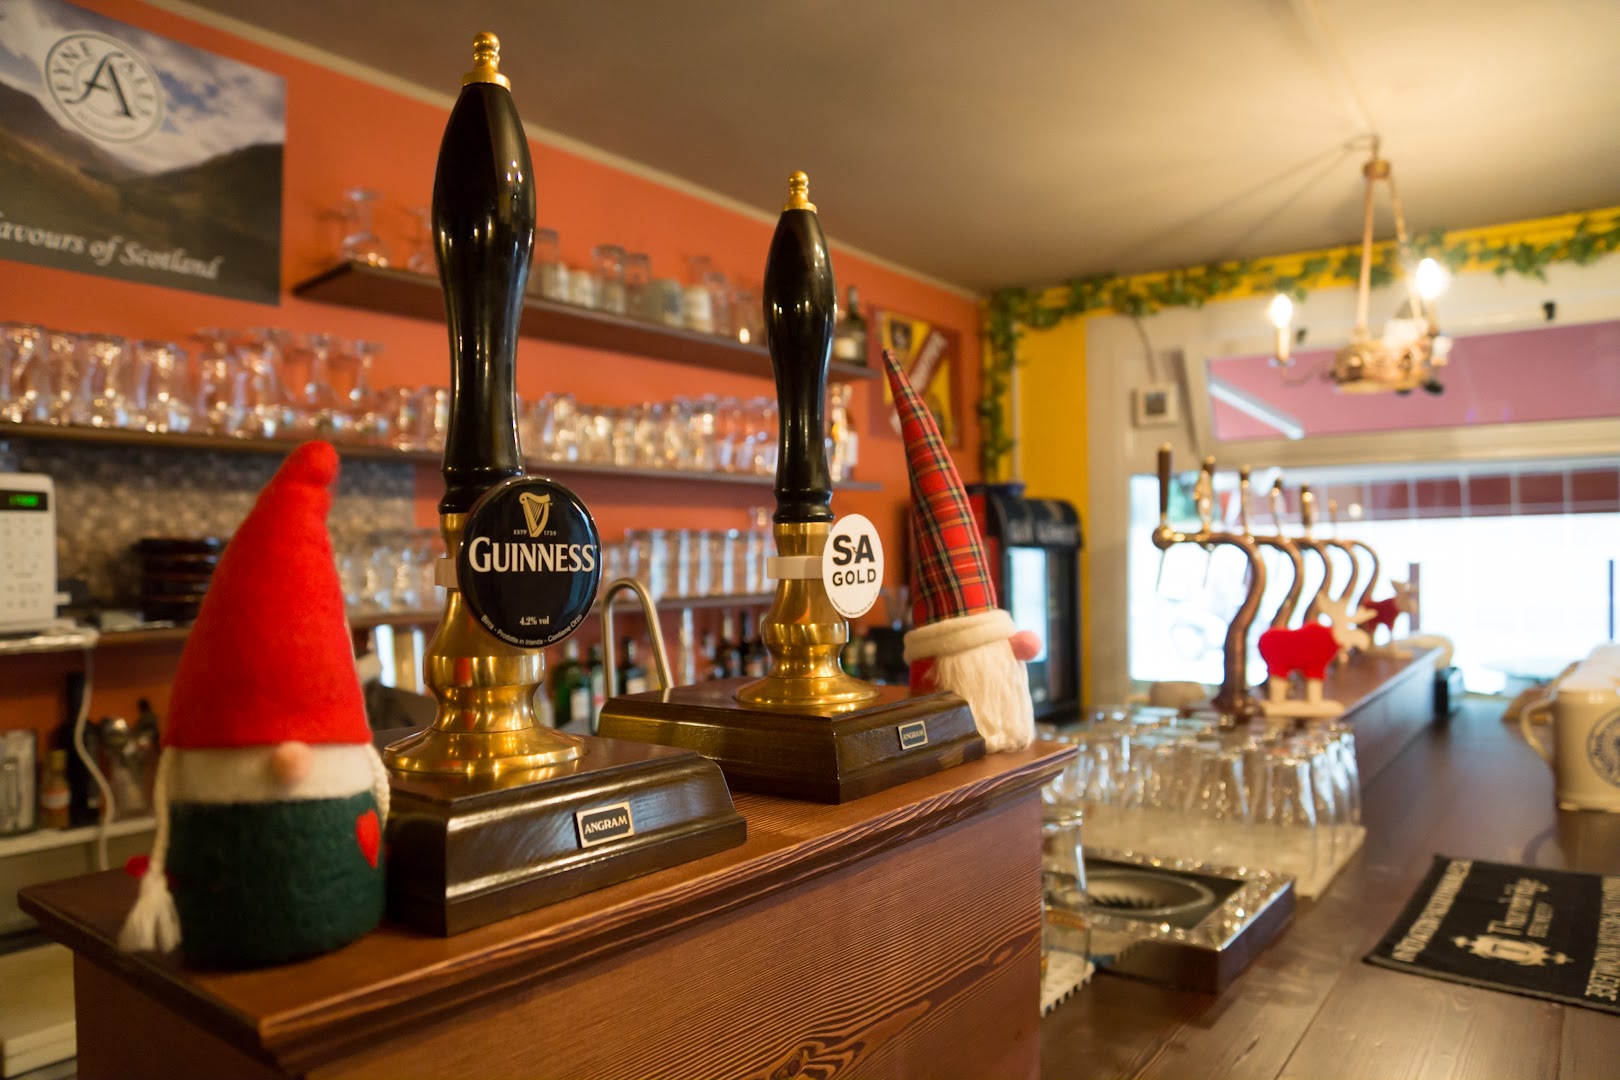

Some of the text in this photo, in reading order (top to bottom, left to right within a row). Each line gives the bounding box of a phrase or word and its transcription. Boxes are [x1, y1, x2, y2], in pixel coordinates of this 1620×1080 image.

[0, 212, 225, 280] avours of Scotland
[468, 536, 595, 573] GUINNESS
[832, 534, 875, 566] SA
[832, 568, 876, 587] GOLD
[481, 614, 495, 630] Birra
[519, 615, 549, 626] 4.2% vol
[902, 730, 925, 741] ANGRAM
[584, 815, 628, 835] ANGRAM
